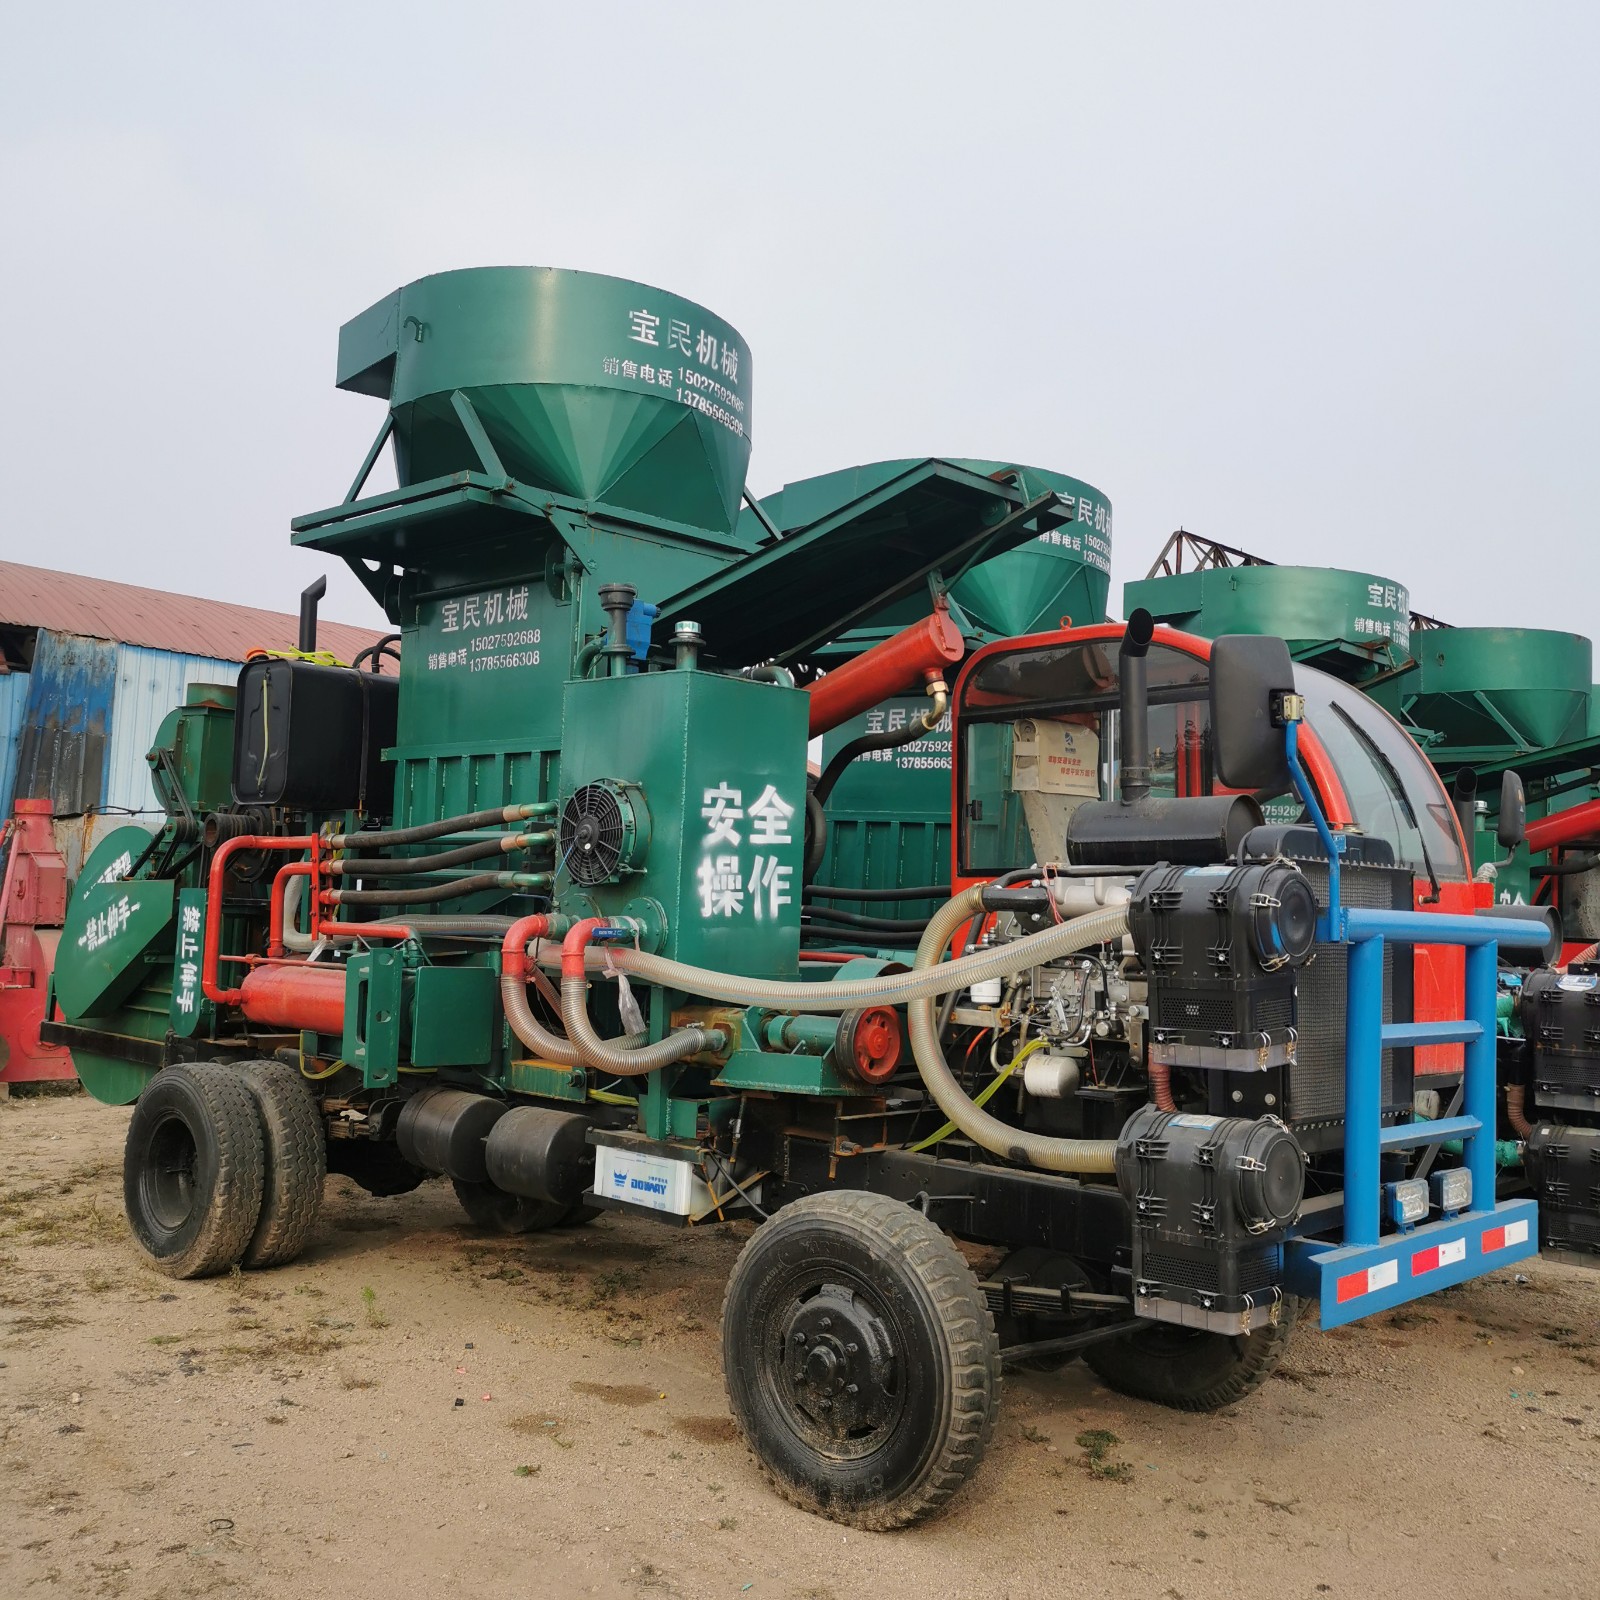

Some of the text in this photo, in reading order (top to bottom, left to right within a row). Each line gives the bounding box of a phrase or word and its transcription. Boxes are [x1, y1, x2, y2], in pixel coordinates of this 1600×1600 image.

[627, 309, 739, 385] 宝民机械
[602, 356, 674, 389] 销售电话
[441, 586, 529, 633] 宝民机械
[1354, 617, 1391, 638] 销售电话
[428, 648, 468, 671] 销售电话
[470, 628, 541, 652] 15027592688
[469, 650, 540, 673] 13785566308
[701, 781, 795, 847] 安全
[697, 855, 793, 921] 操作
[86, 895, 131, 952] 禁止伸手
